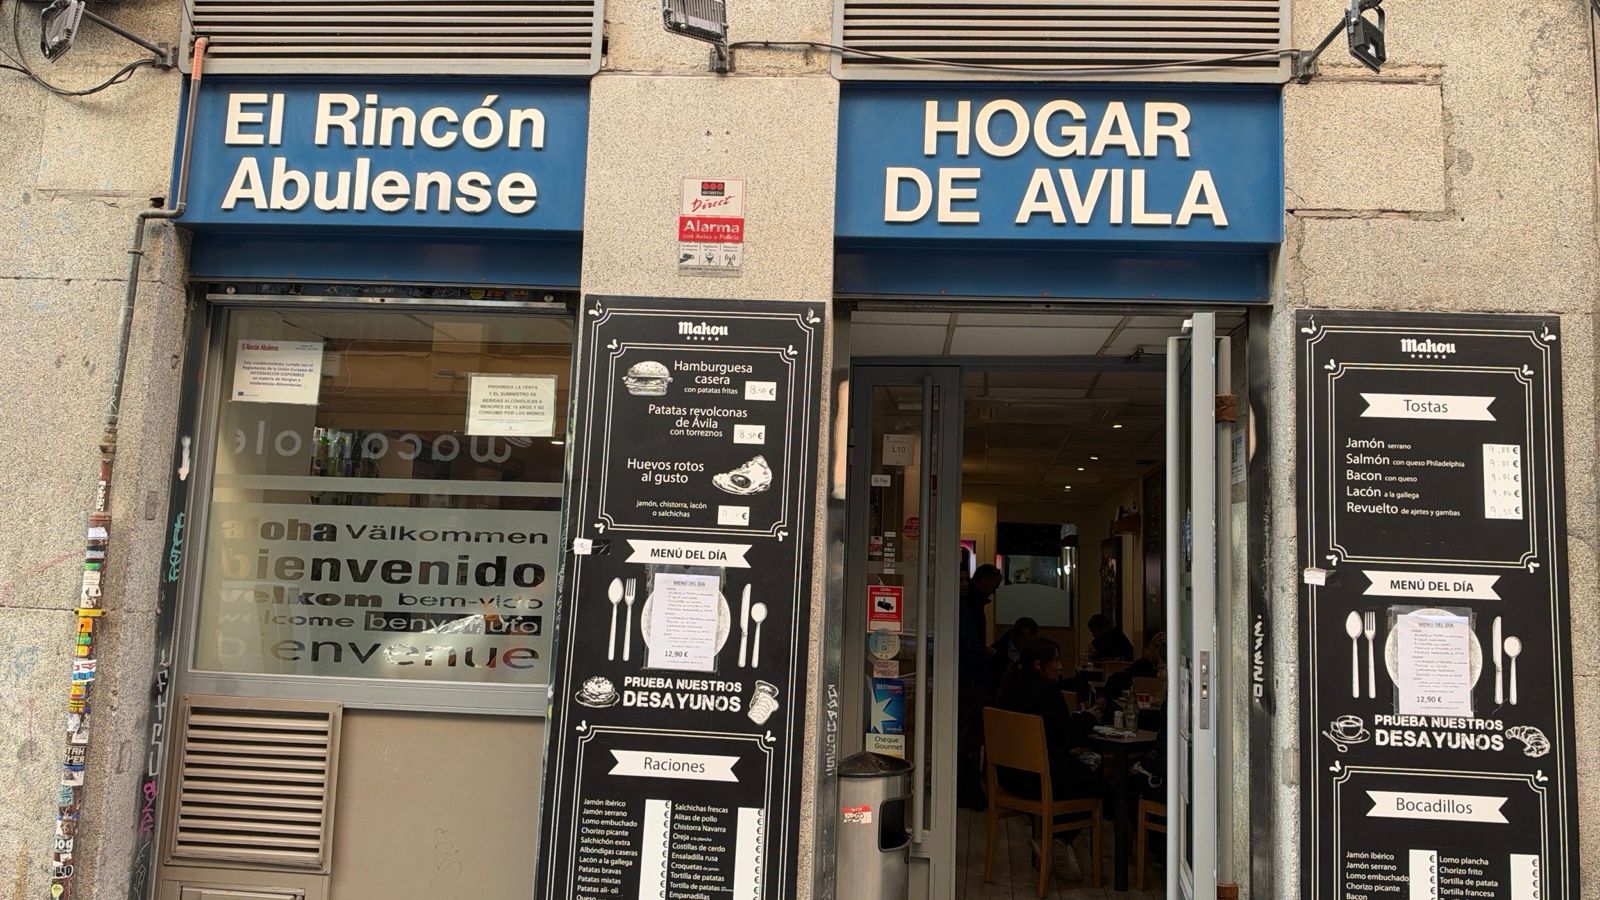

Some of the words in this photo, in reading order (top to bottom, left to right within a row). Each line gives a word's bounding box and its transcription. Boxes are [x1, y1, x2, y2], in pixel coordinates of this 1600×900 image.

[225, 93, 285, 146] El
[315, 92, 545, 149] Rincón
[924, 98, 1191, 158] HOGAR
[221, 156, 538, 215] Abulense
[884, 167, 981, 223] DE
[1014, 167, 1229, 227] AVILA
[691, 195, 736, 212] Direct
[684, 220, 740, 232] Alarma
[678, 322, 728, 335] Mahou
[1400, 339, 1456, 353] Mahou
[674, 360, 752, 374] Hamburguesa
[695, 376, 730, 384] casera
[649, 404, 687, 415] Patatas
[690, 407, 747, 417] revolconas
[1403, 400, 1448, 413] Tostas
[676, 417, 689, 427] de
[692, 416, 718, 428] Ávila
[686, 429, 722, 437] torreznos
[1346, 438, 1384, 448] Jamón
[1346, 454, 1390, 464] Salmón
[628, 458, 671, 470] Huevos
[674, 462, 704, 471] rotos
[641, 470, 651, 481] al
[655, 473, 688, 484] gusto
[1347, 470, 1382, 480] Bacon
[1347, 486, 1381, 497] Lacón
[1347, 502, 1398, 514] Revuelto
[346, 522, 548, 548] Välkommen
[650, 546, 682, 558] MENÚ
[686, 550, 705, 559] DEL
[708, 550, 727, 560] DÍA
[222, 547, 546, 588] bienvenido
[1390, 578, 1424, 590] MENÚ
[1428, 582, 1450, 591] DEL
[1454, 581, 1474, 592] DÍA
[665, 651, 682, 659] 12,90
[624, 676, 673, 689] PRUEBA
[676, 679, 742, 692] NUESTROS
[623, 690, 741, 712] DESAYUNOS
[1417, 696, 1436, 704] 12,90
[1375, 715, 1428, 727] PRUEBA
[1431, 716, 1503, 730] NUESTROS
[875, 736, 899, 744] Cheque
[1375, 729, 1505, 751] DESAYUNOS
[875, 742, 903, 751] Gourmet
[644, 757, 705, 773] Raciones
[675, 804, 706, 812] Salchichas
[708, 805, 728, 813] frescas
[1397, 798, 1472, 814] Bocadillos
[601, 819, 638, 827] embuchado
[673, 823, 701, 831] Chistorra
[581, 827, 605, 835] Chorizo
[673, 833, 689, 841] Oreja
[580, 846, 614, 855] Albóndigas
[672, 842, 697, 850] Costillas
[672, 852, 704, 860] Ensaladilla
[1371, 852, 1394, 860] ibérico
[1440, 856, 1460, 864] Lomo
[1461, 857, 1489, 865] plancha
[610, 858, 632, 867] gallega
[671, 862, 702, 870] Croquetas
[1440, 866, 1466, 874] Chorizo
[578, 875, 600, 883] Patatas
[1346, 872, 1366, 880] Lomo
[1367, 874, 1410, 882] embuchado
[1440, 877, 1464, 885] Tortilla
[1346, 882, 1373, 890] Chorizo
[1374, 884, 1400, 892] picante
[1440, 887, 1464, 895] Tortilla
[1465, 888, 1494, 897] francesa
